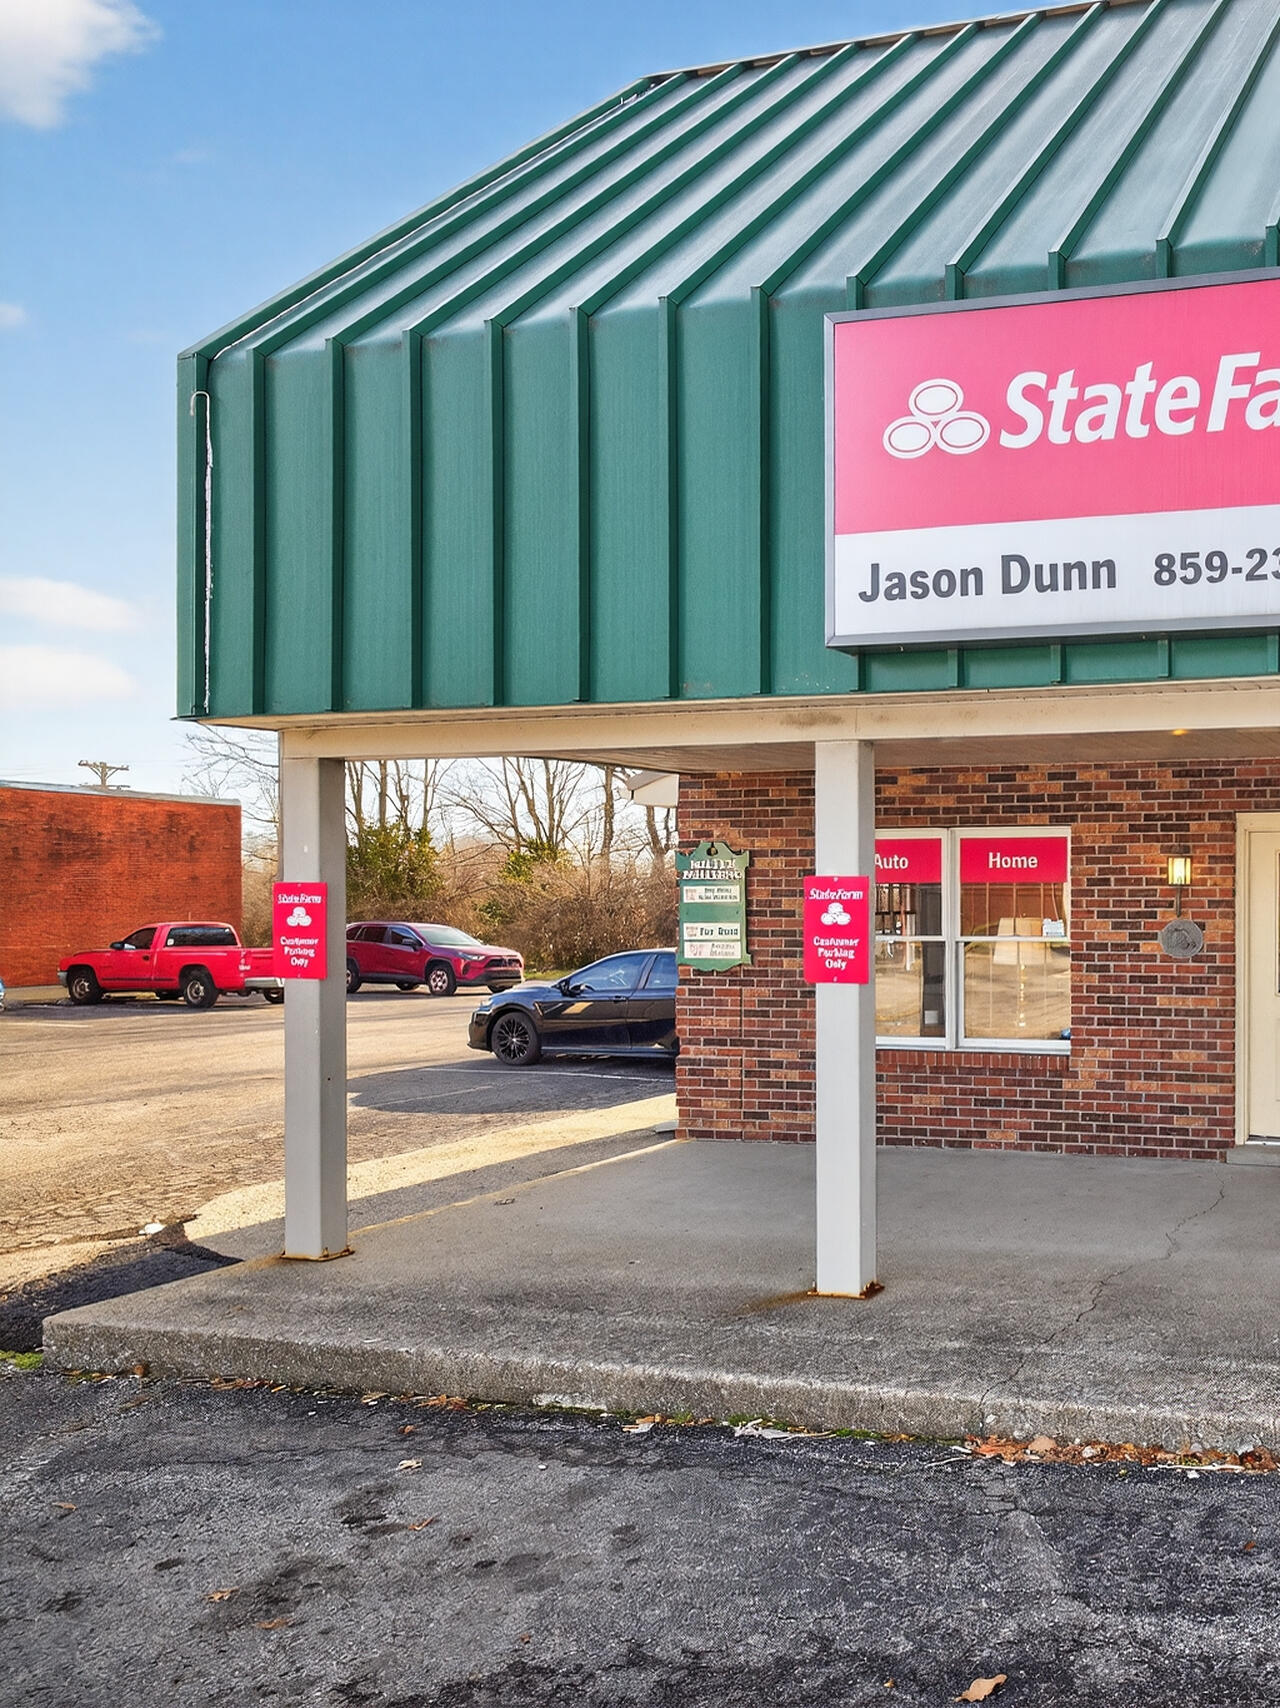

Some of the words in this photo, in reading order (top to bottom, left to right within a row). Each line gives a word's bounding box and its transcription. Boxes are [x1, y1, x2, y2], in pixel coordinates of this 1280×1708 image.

[858, 561, 984, 603] Jason
[1000, 553, 1117, 595] Dunn
[875, 854, 909, 869] Auto
[988, 852, 1038, 869] Home
[813, 936, 859, 946] Customer
[818, 948, 855, 959] Parking
[825, 958, 847, 971] Only
